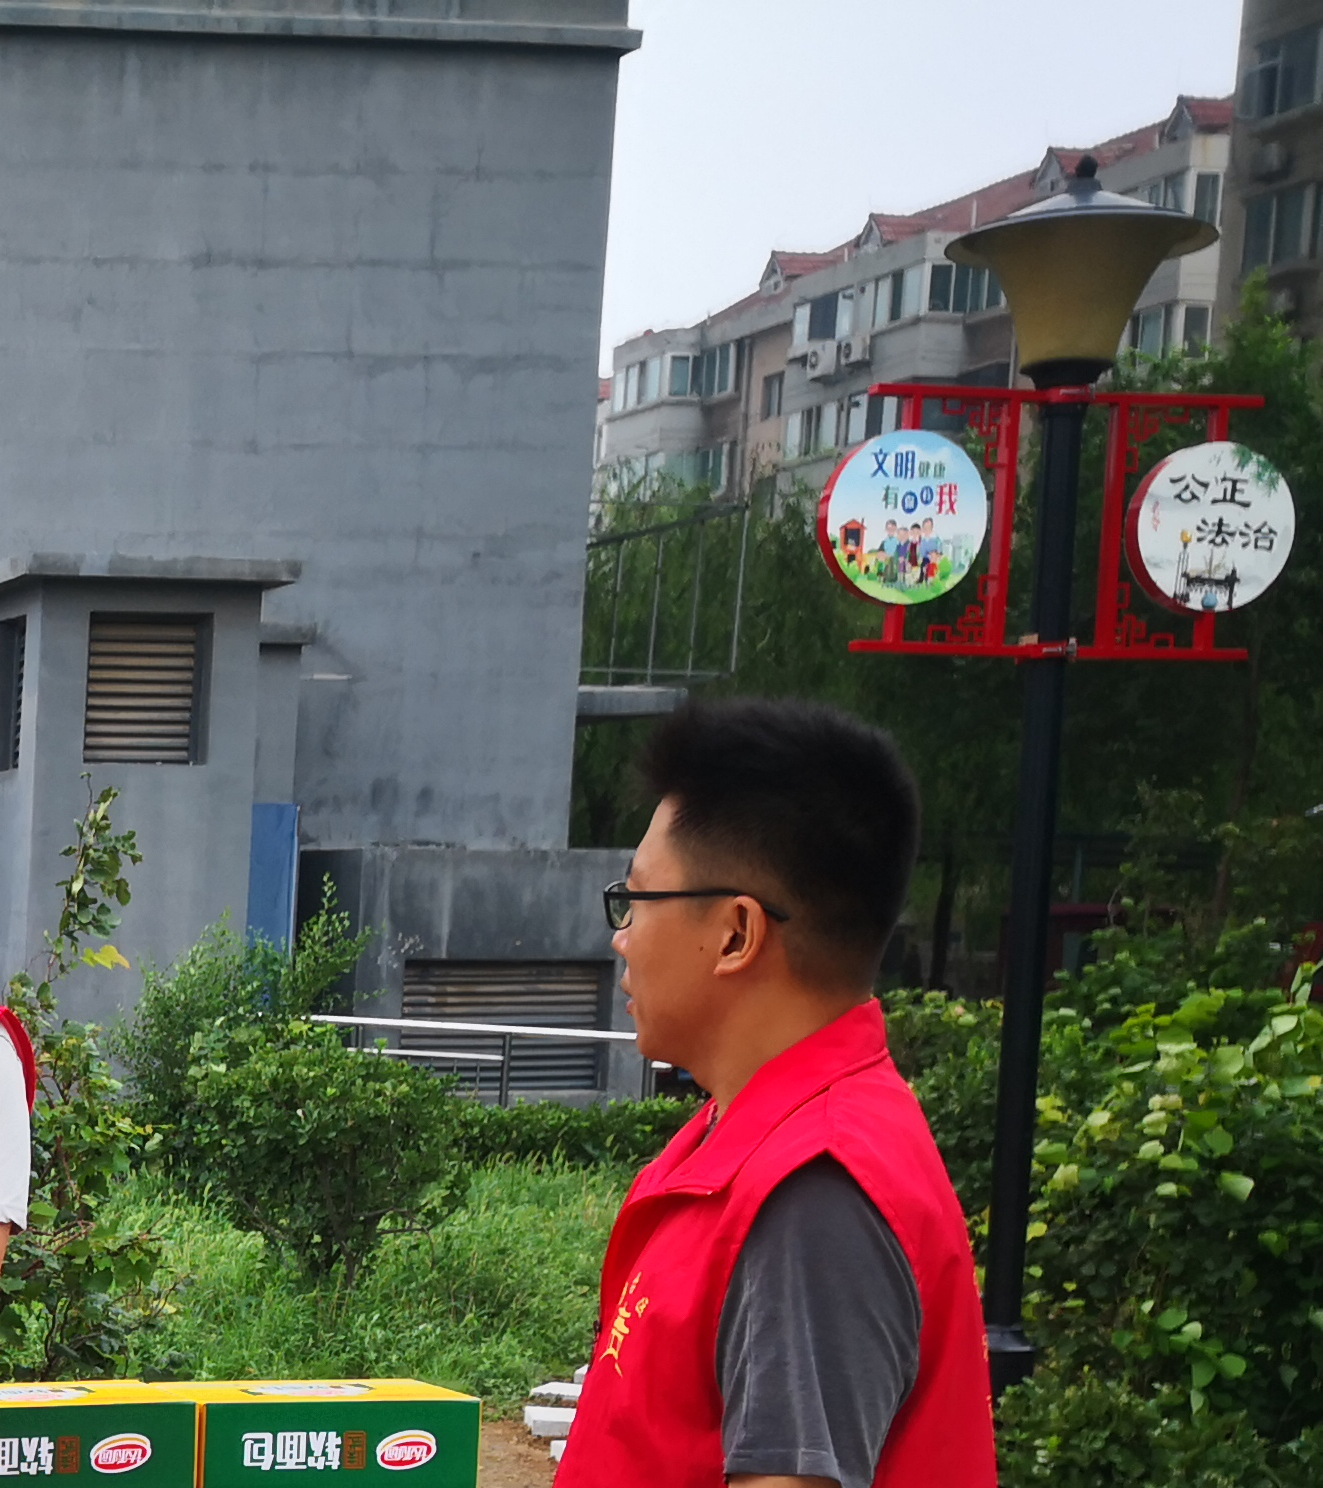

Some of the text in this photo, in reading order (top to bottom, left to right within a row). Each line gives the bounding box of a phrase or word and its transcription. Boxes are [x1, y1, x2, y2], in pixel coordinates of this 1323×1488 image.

[1168, 472, 1251, 508] 公正
[1195, 517, 1278, 551] 法治
[241, 1430, 342, 1471] 软面包
